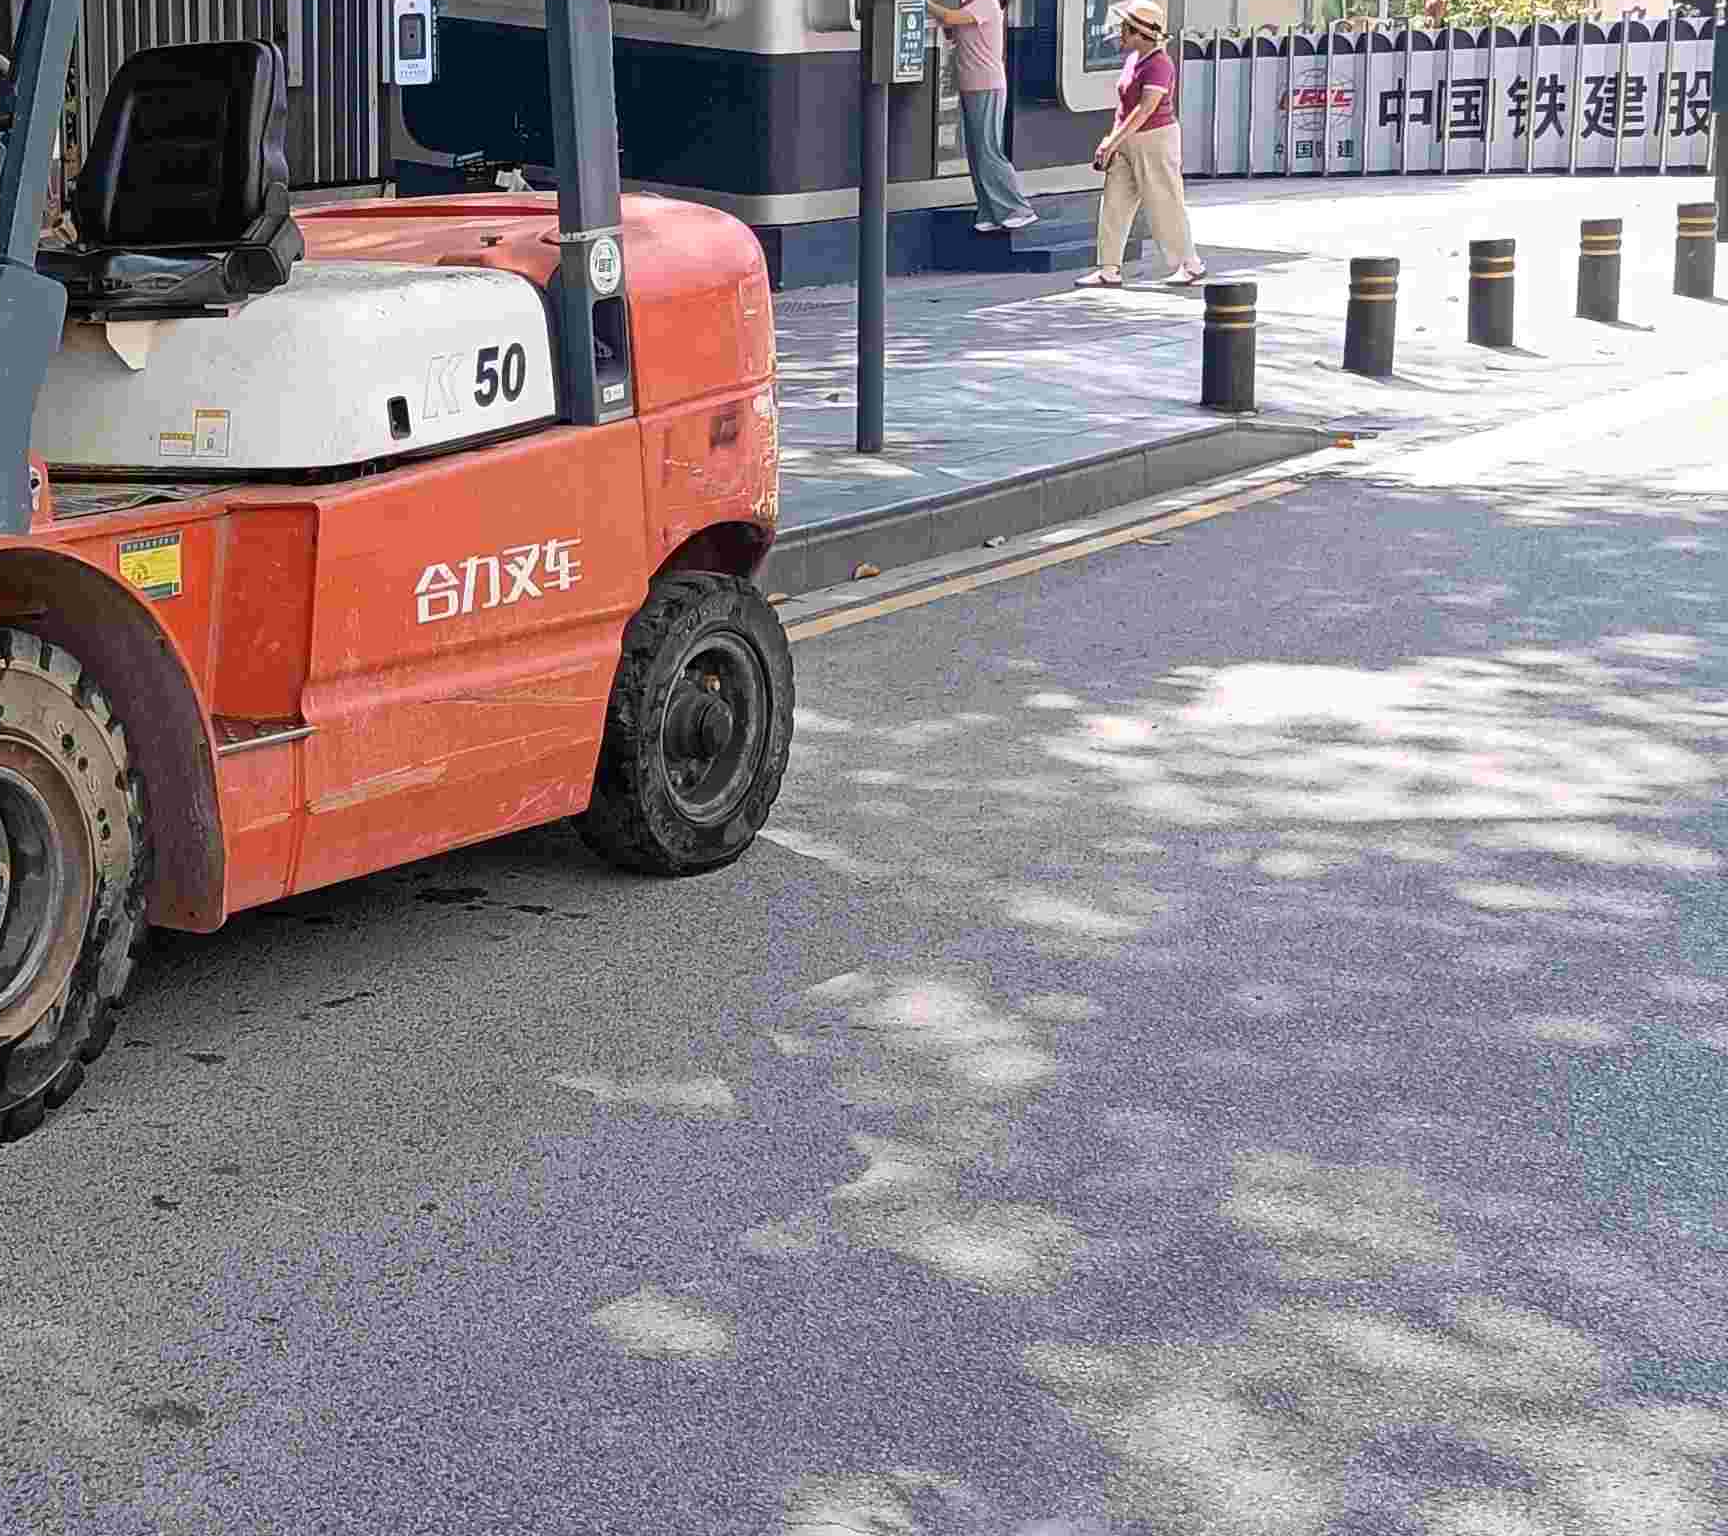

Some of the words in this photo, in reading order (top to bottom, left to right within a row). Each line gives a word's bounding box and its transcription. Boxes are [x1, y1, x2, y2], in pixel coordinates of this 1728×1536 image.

[472, 342, 526, 407] 50
[414, 538, 583, 624] 合力叉车
